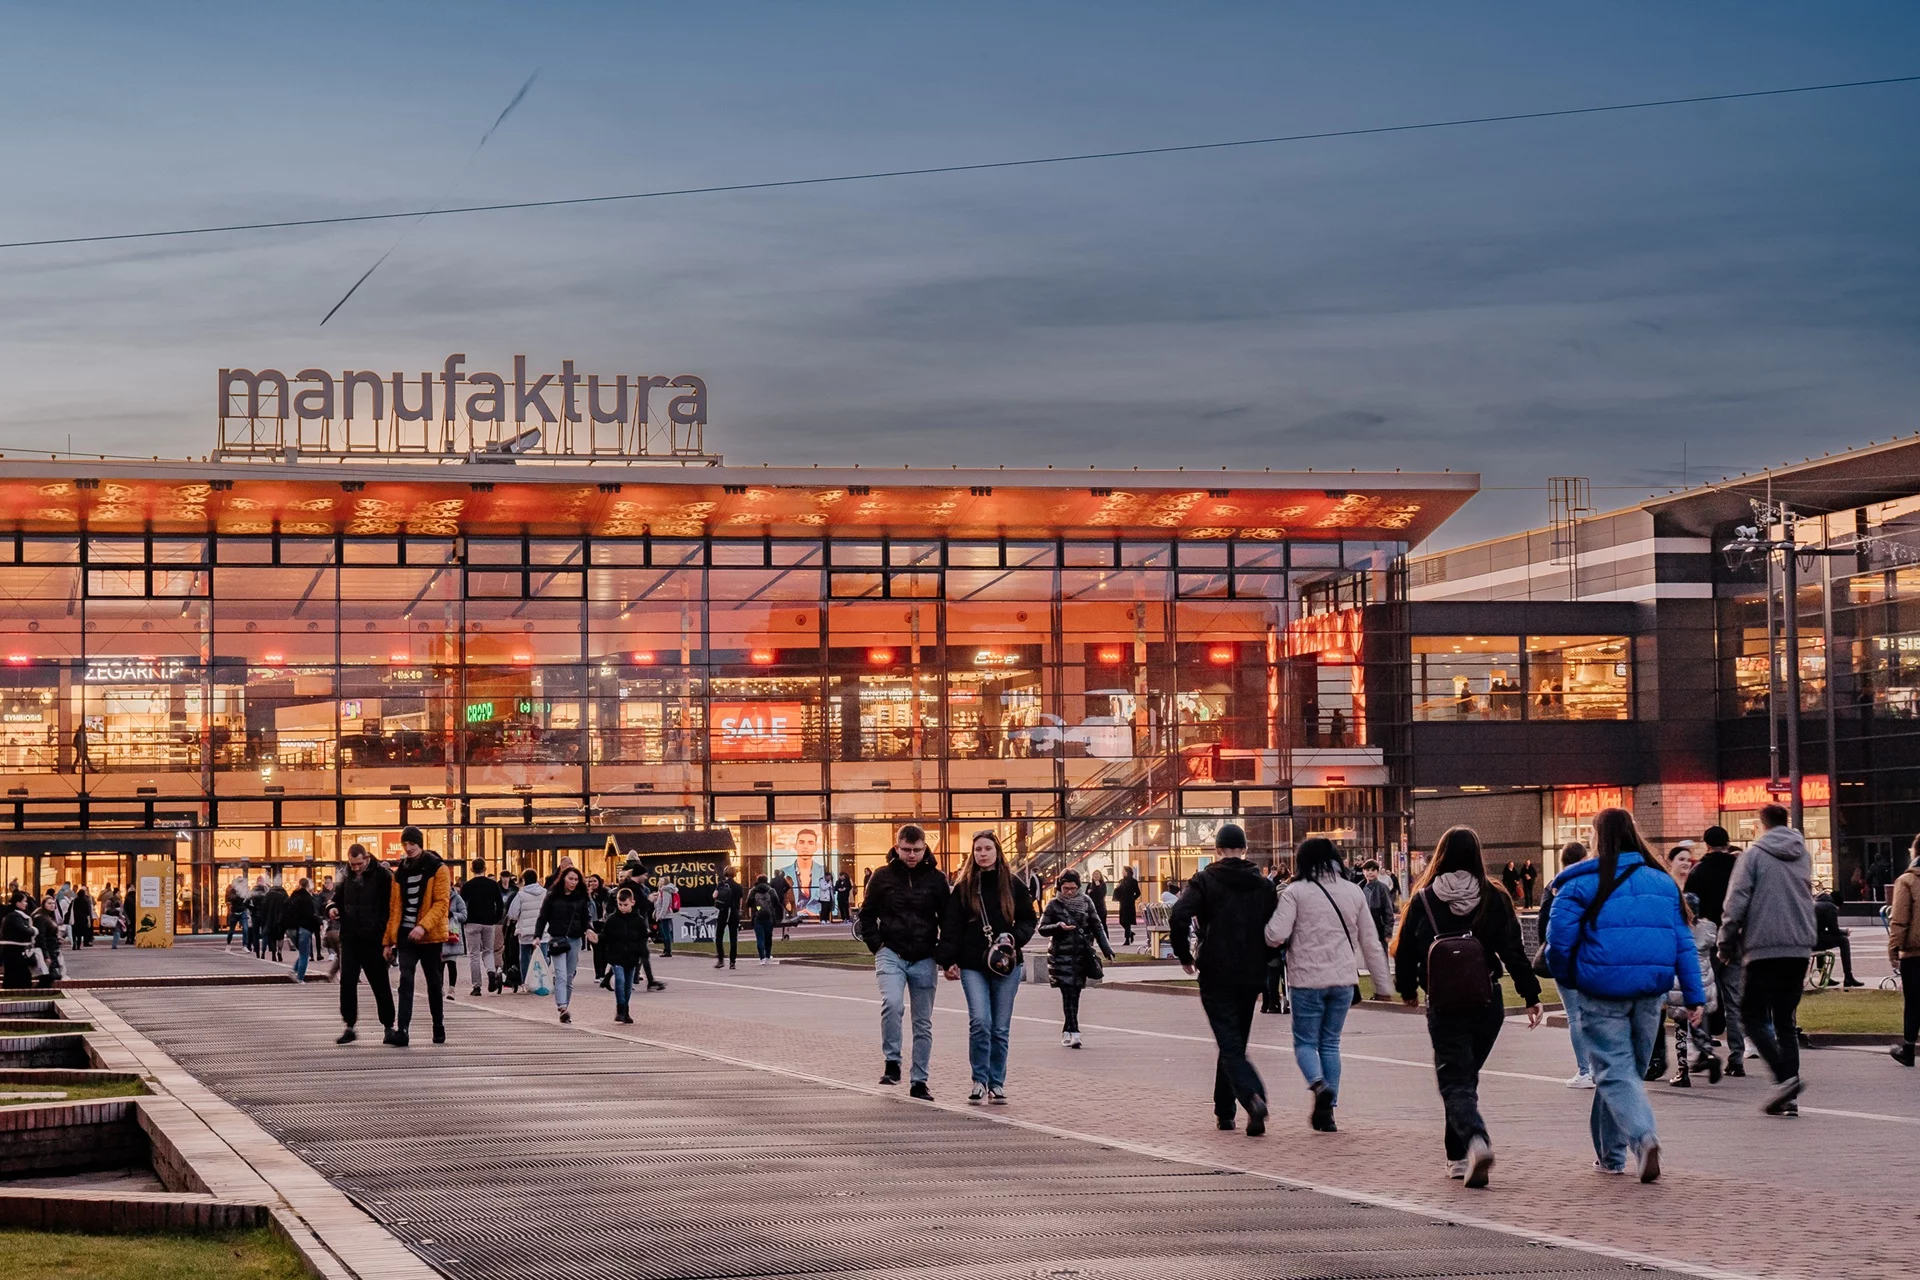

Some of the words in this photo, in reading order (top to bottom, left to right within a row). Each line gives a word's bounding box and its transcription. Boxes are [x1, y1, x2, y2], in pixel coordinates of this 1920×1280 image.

[219, 353, 707, 423] manufaktura
[1880, 638, 1920, 650] PSIB
[4, 714, 42, 722] SYMBIOSIS
[721, 717, 787, 739] SALE
[213, 838, 244, 849] PART
[1170, 847, 1202, 855] KNTOR
[654, 861, 715, 876] GRZANIEC
[681, 924, 716, 939] PLAN
